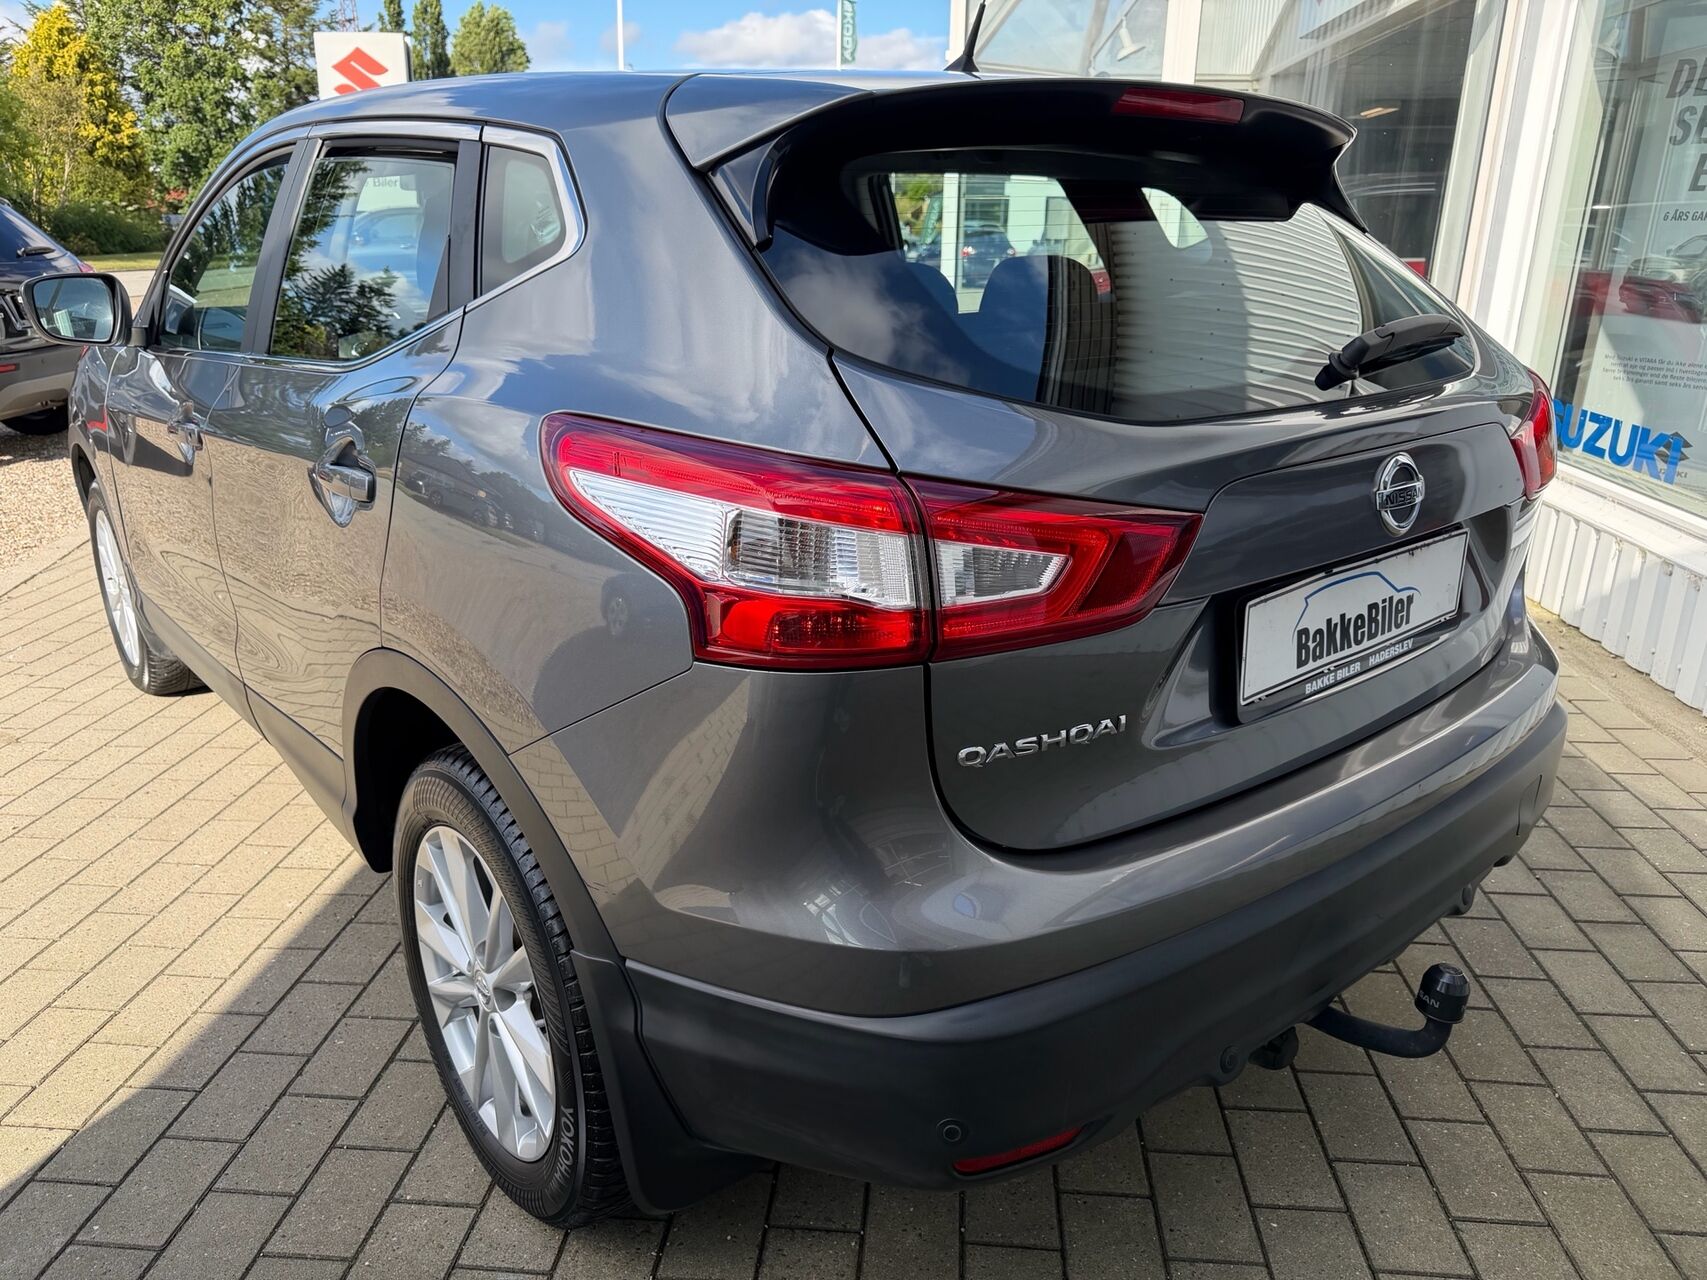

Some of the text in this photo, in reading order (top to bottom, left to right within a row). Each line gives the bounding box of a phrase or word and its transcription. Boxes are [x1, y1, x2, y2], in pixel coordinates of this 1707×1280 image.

[1663, 211, 1670, 222] 6
[1671, 207, 1690, 222] ÅRS
[1384, 488, 1424, 507] NISSAN
[1295, 593, 1415, 669] BakkeBiler
[1304, 638, 1415, 695] BAKKE BILER HADERSLEV
[957, 714, 1127, 768] QASHQAI
